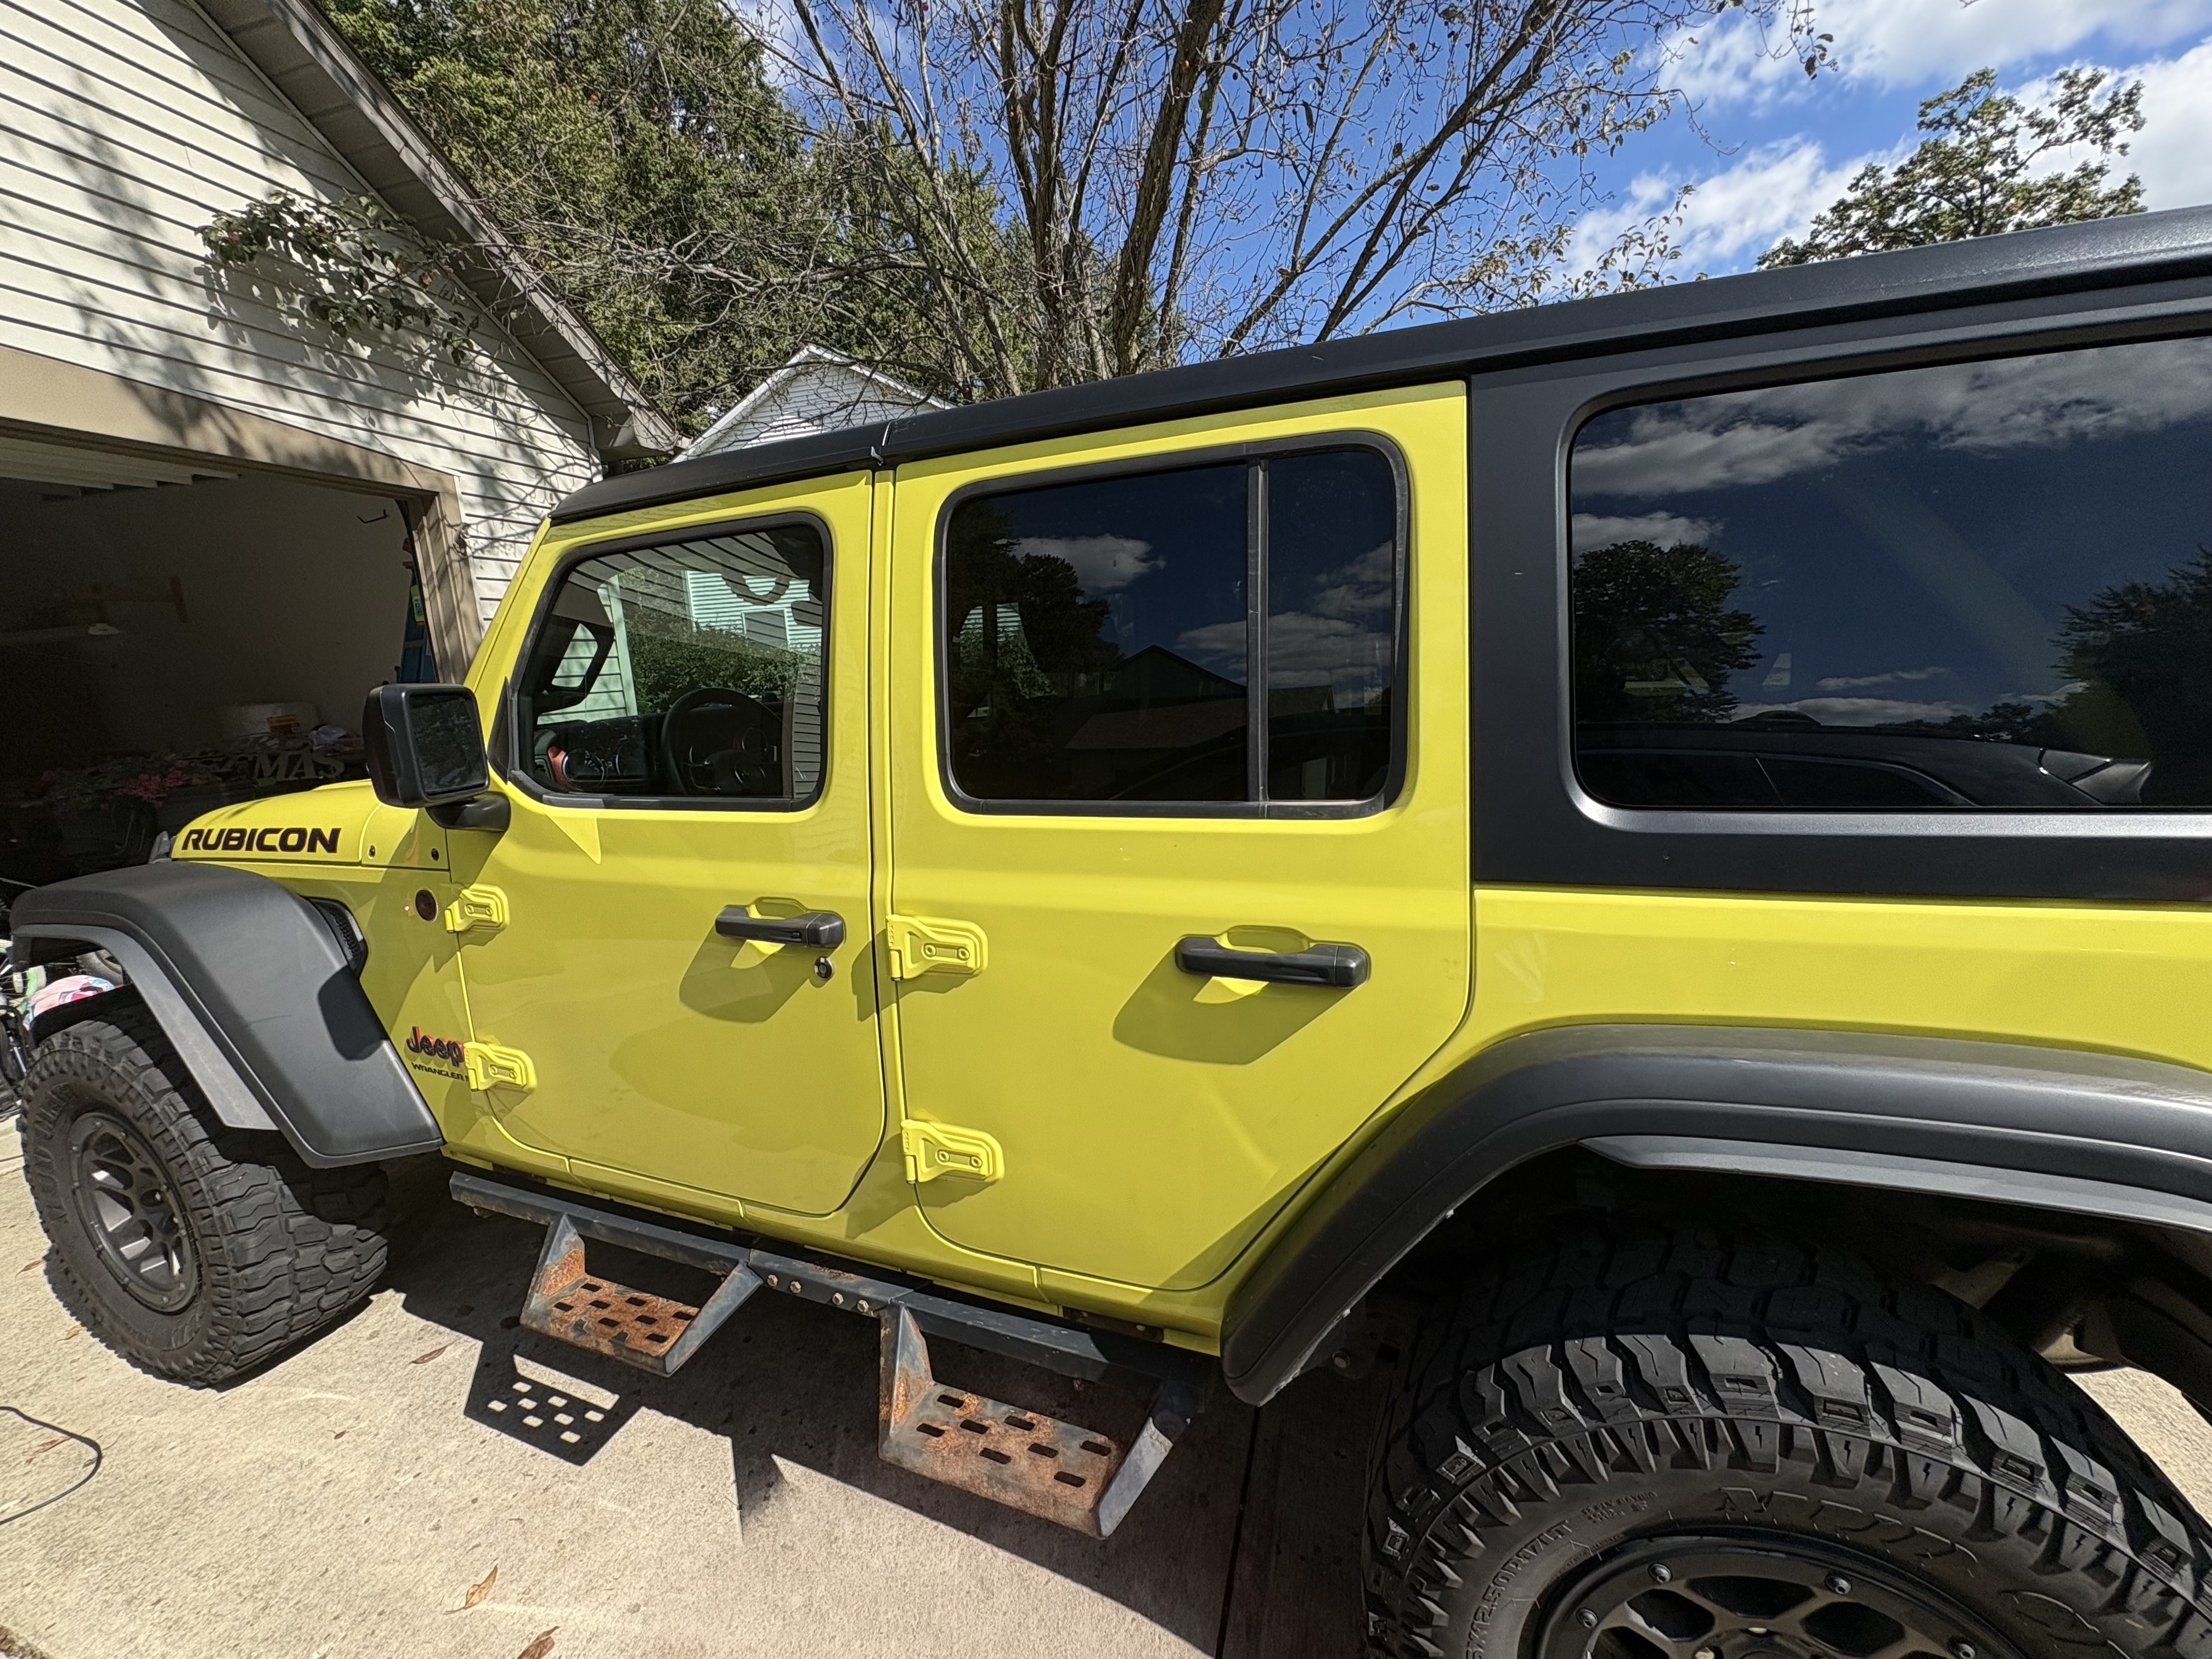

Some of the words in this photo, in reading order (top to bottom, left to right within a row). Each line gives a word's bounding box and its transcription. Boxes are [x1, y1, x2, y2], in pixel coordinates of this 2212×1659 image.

[182, 827, 341, 853] RUBICON
[407, 1026, 465, 1066] Jeep
[411, 1062, 465, 1081] WRANGLER
